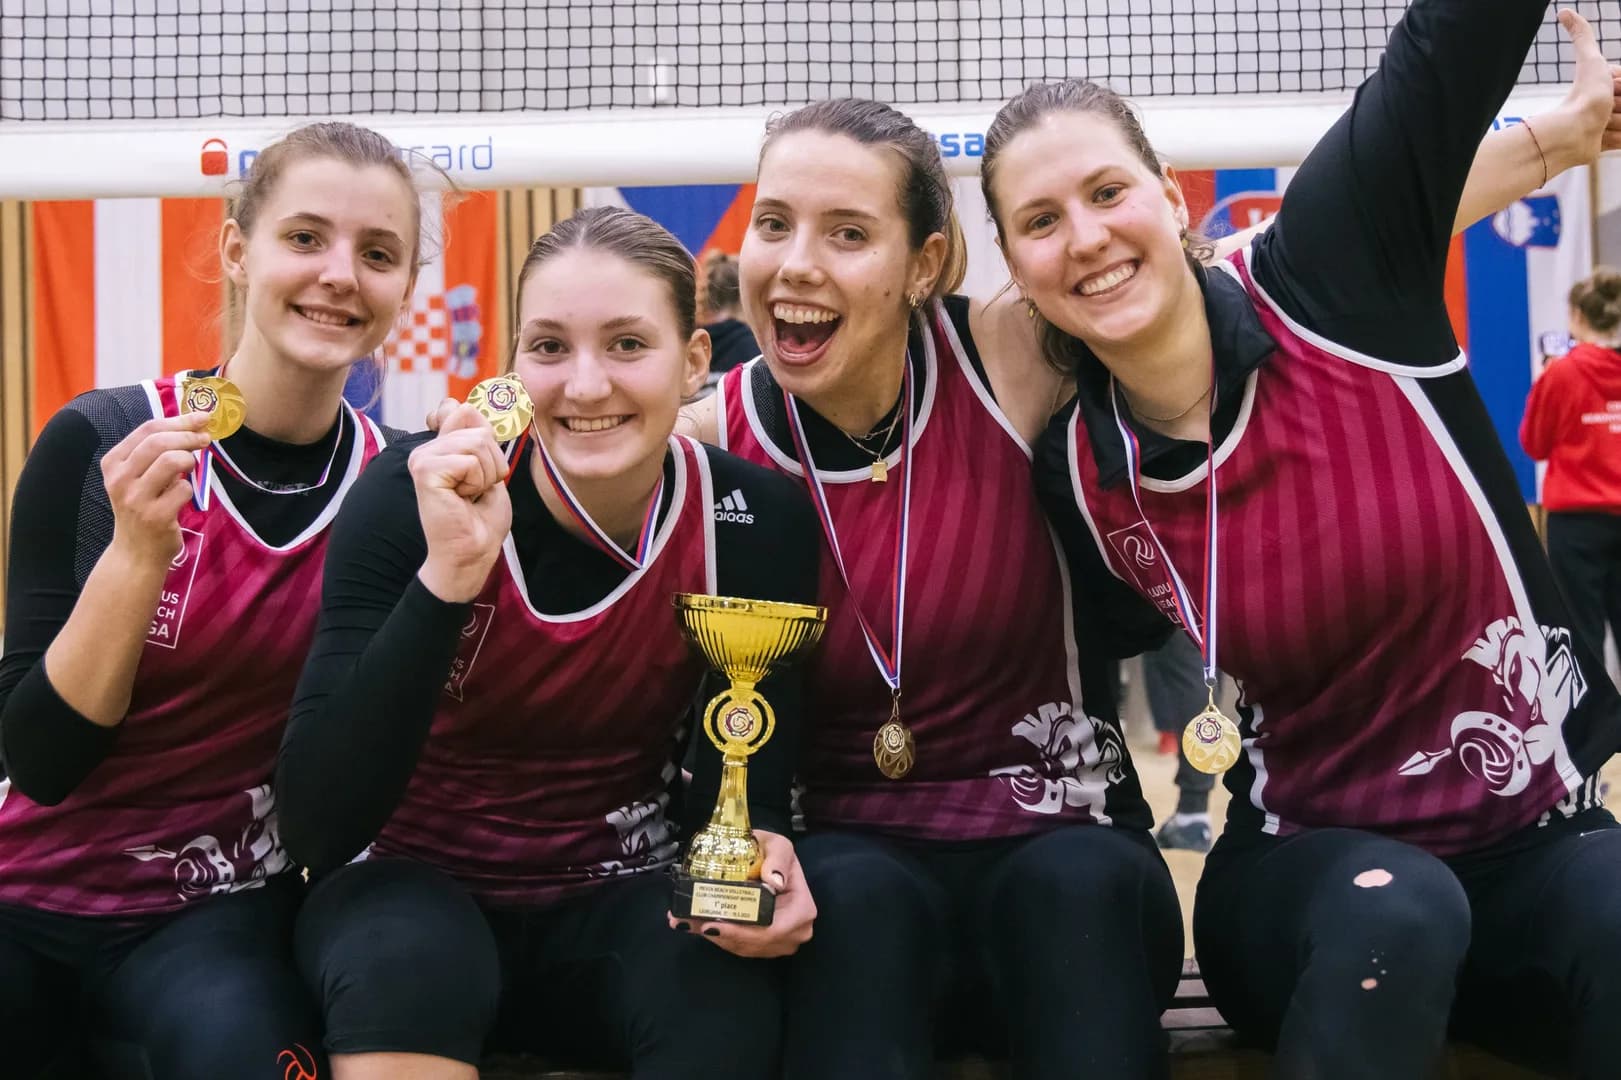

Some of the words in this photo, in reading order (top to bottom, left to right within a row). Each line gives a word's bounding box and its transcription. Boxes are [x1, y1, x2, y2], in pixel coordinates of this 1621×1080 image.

[161, 590, 179, 604] US
[1147, 582, 1172, 598] LUDU
[156, 606, 175, 620] CH
